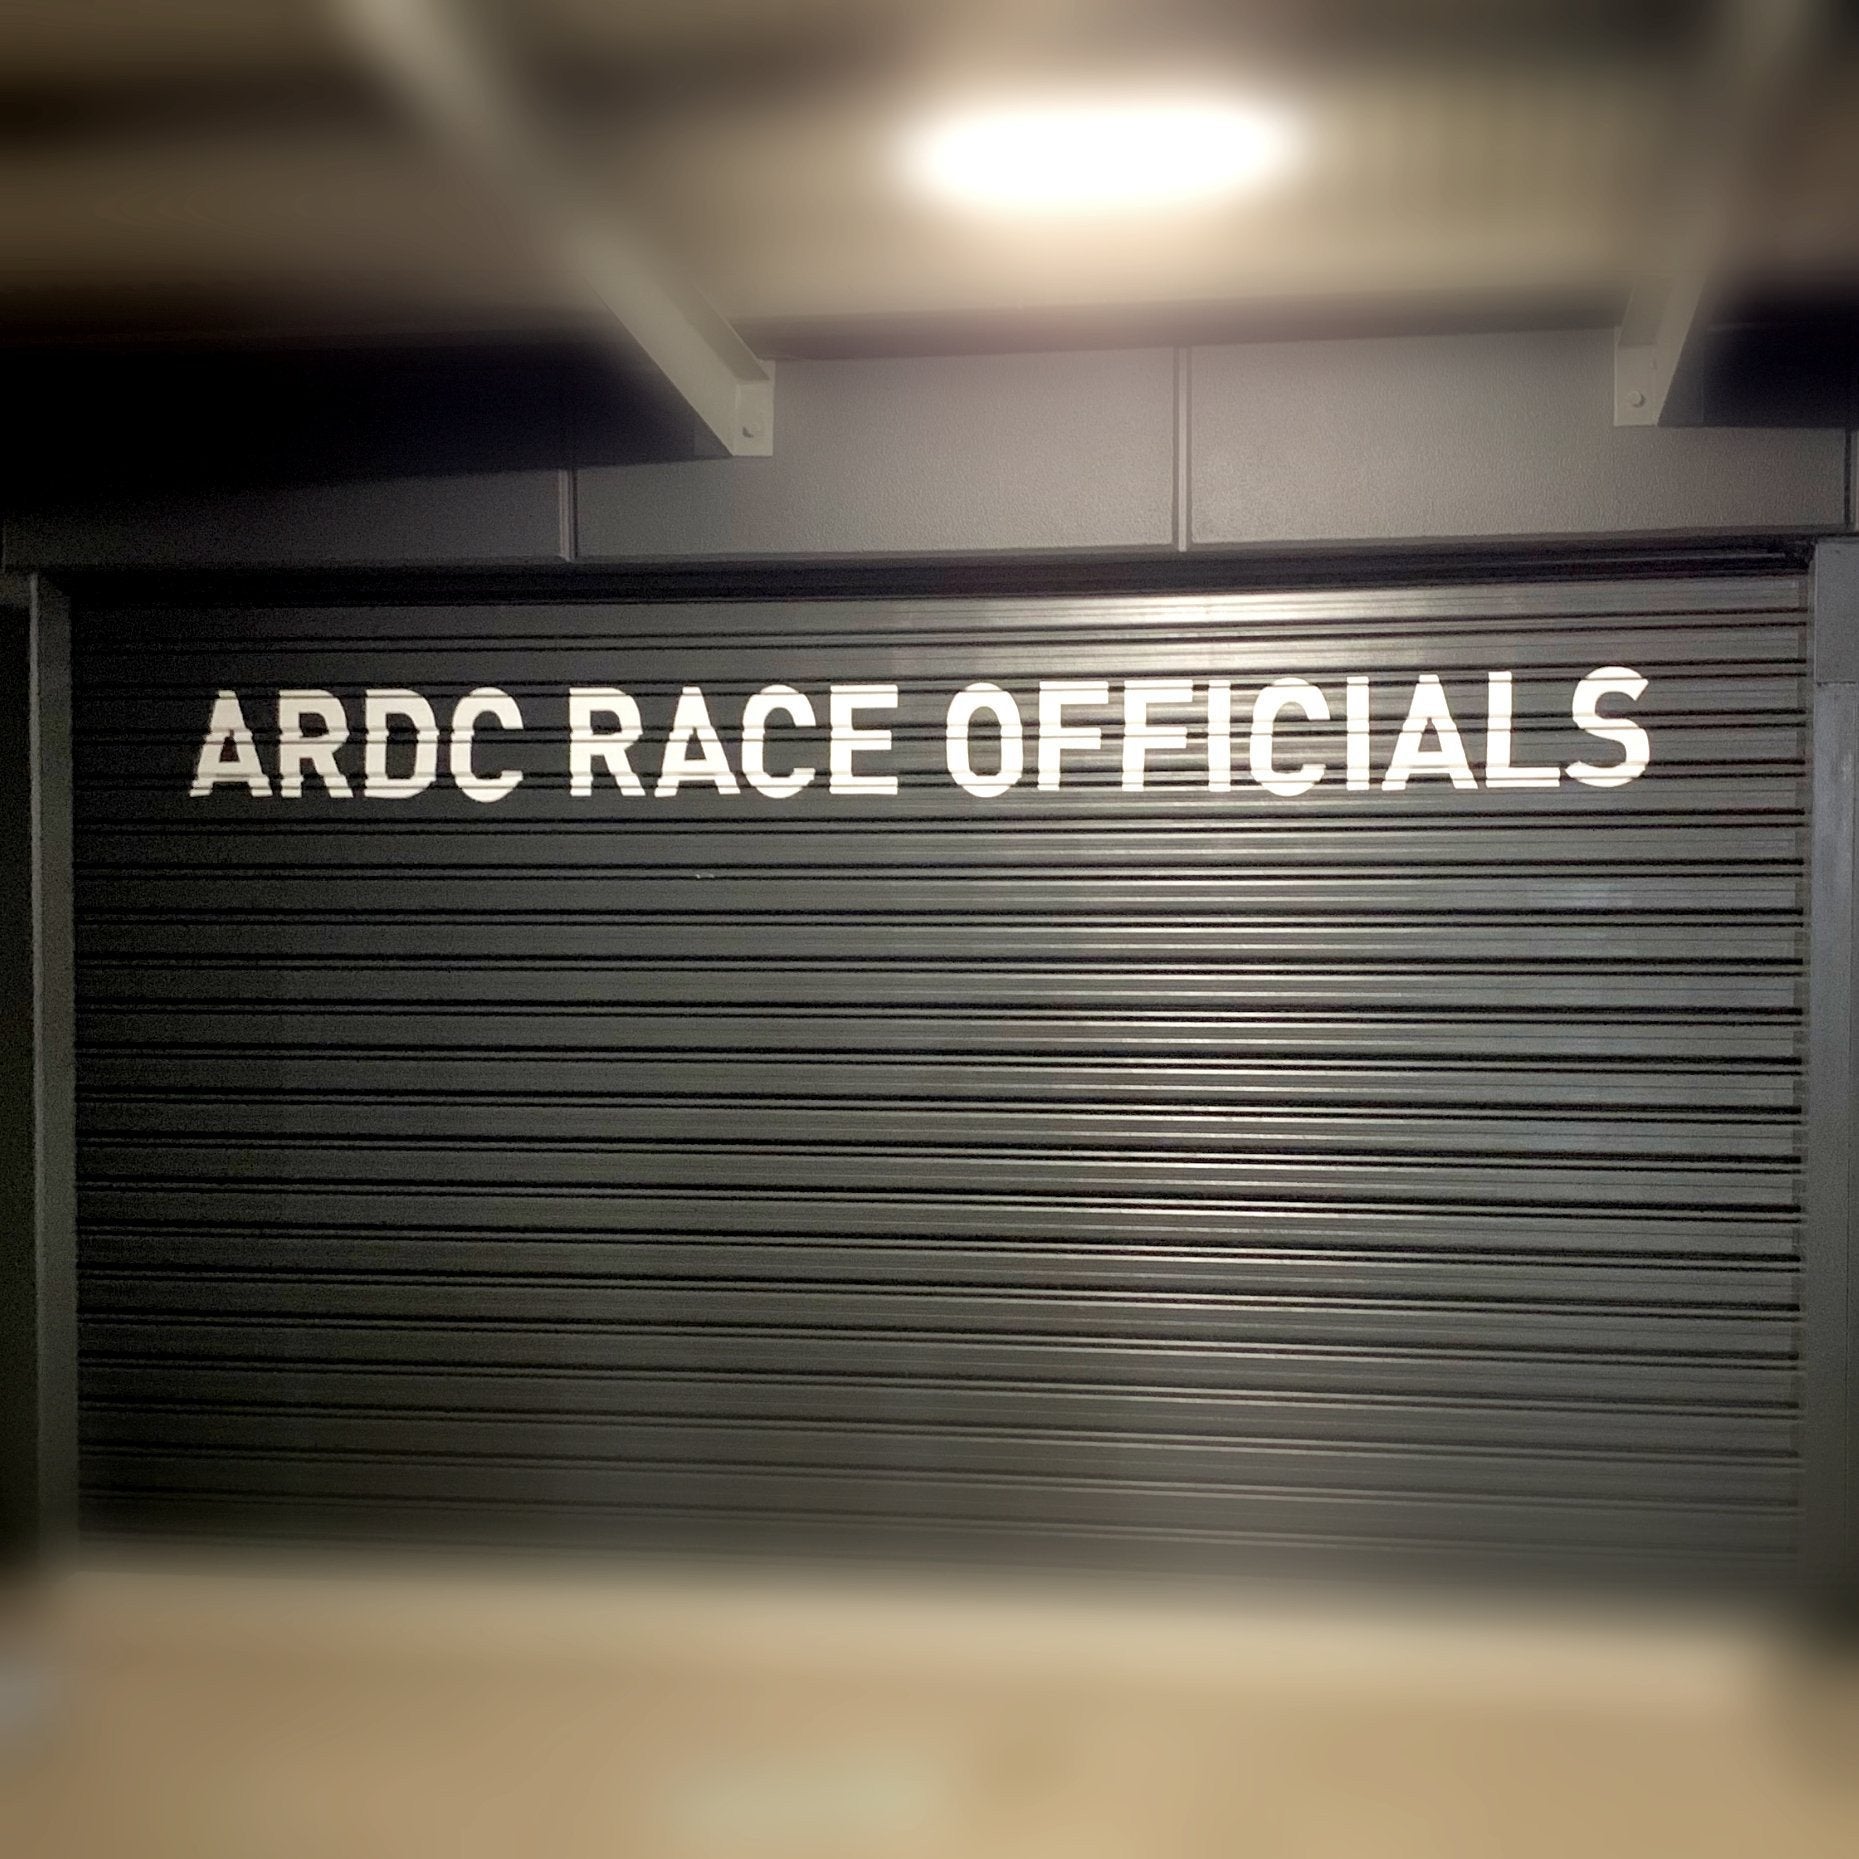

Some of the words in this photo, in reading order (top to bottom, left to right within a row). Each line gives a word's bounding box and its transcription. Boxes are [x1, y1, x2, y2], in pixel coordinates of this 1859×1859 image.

[189, 686, 525, 803] ARDC
[568, 684, 900, 799] RACE
[945, 666, 1651, 799] OFFICIALS
